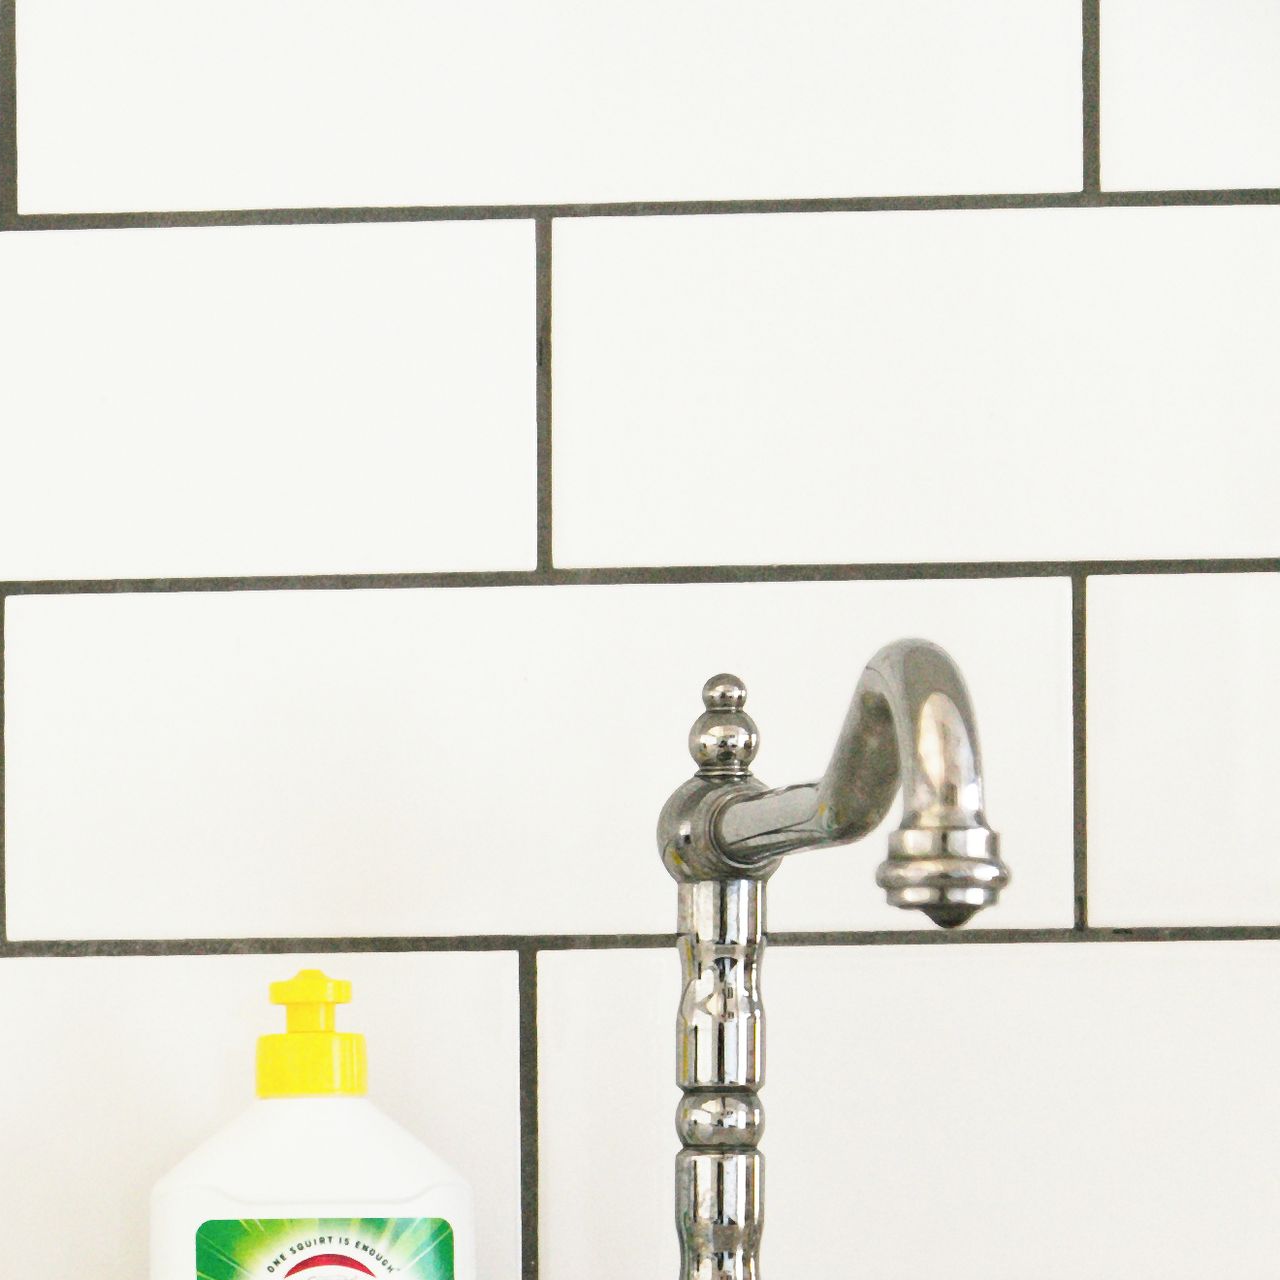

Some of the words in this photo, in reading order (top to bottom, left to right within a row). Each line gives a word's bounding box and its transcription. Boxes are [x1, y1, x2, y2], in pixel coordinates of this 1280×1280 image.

[267, 1253, 287, 1273] ONE
[290, 1236, 333, 1254] SQUIRT
[339, 1237, 349, 1246] IS
